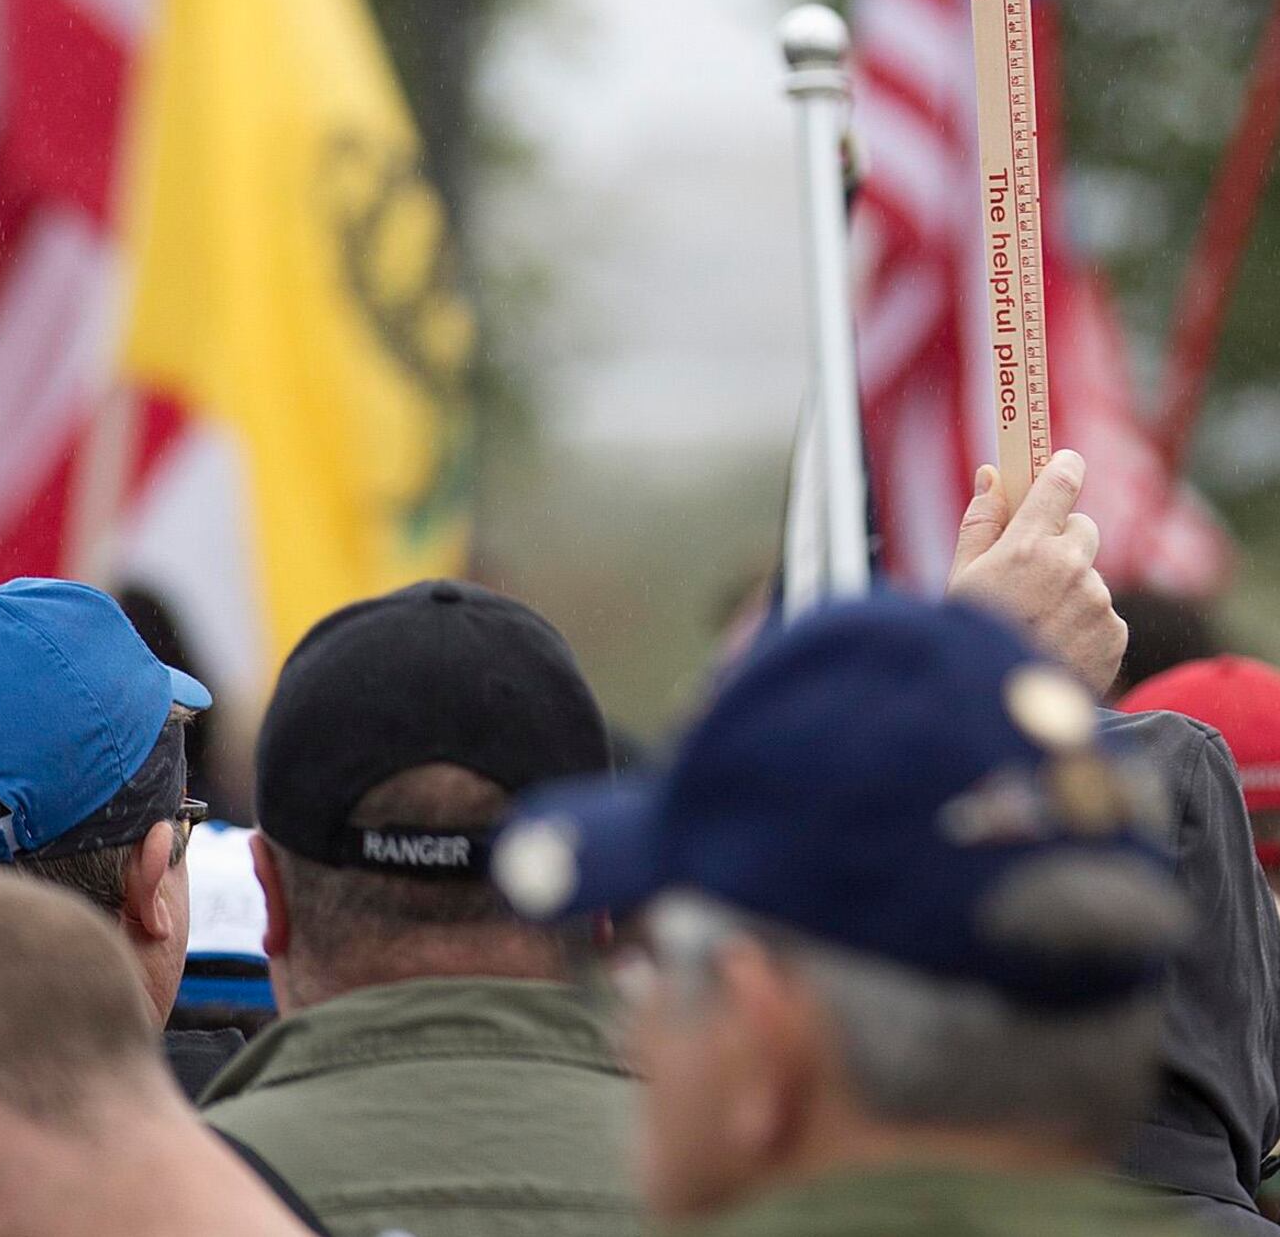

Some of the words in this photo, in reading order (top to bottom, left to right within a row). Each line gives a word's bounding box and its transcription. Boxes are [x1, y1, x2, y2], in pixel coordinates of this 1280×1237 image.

[988, 168, 1010, 224] The
[990, 232, 1017, 334] helpful
[993, 344, 1020, 431] place.
[362, 829, 470, 866] RANGER
